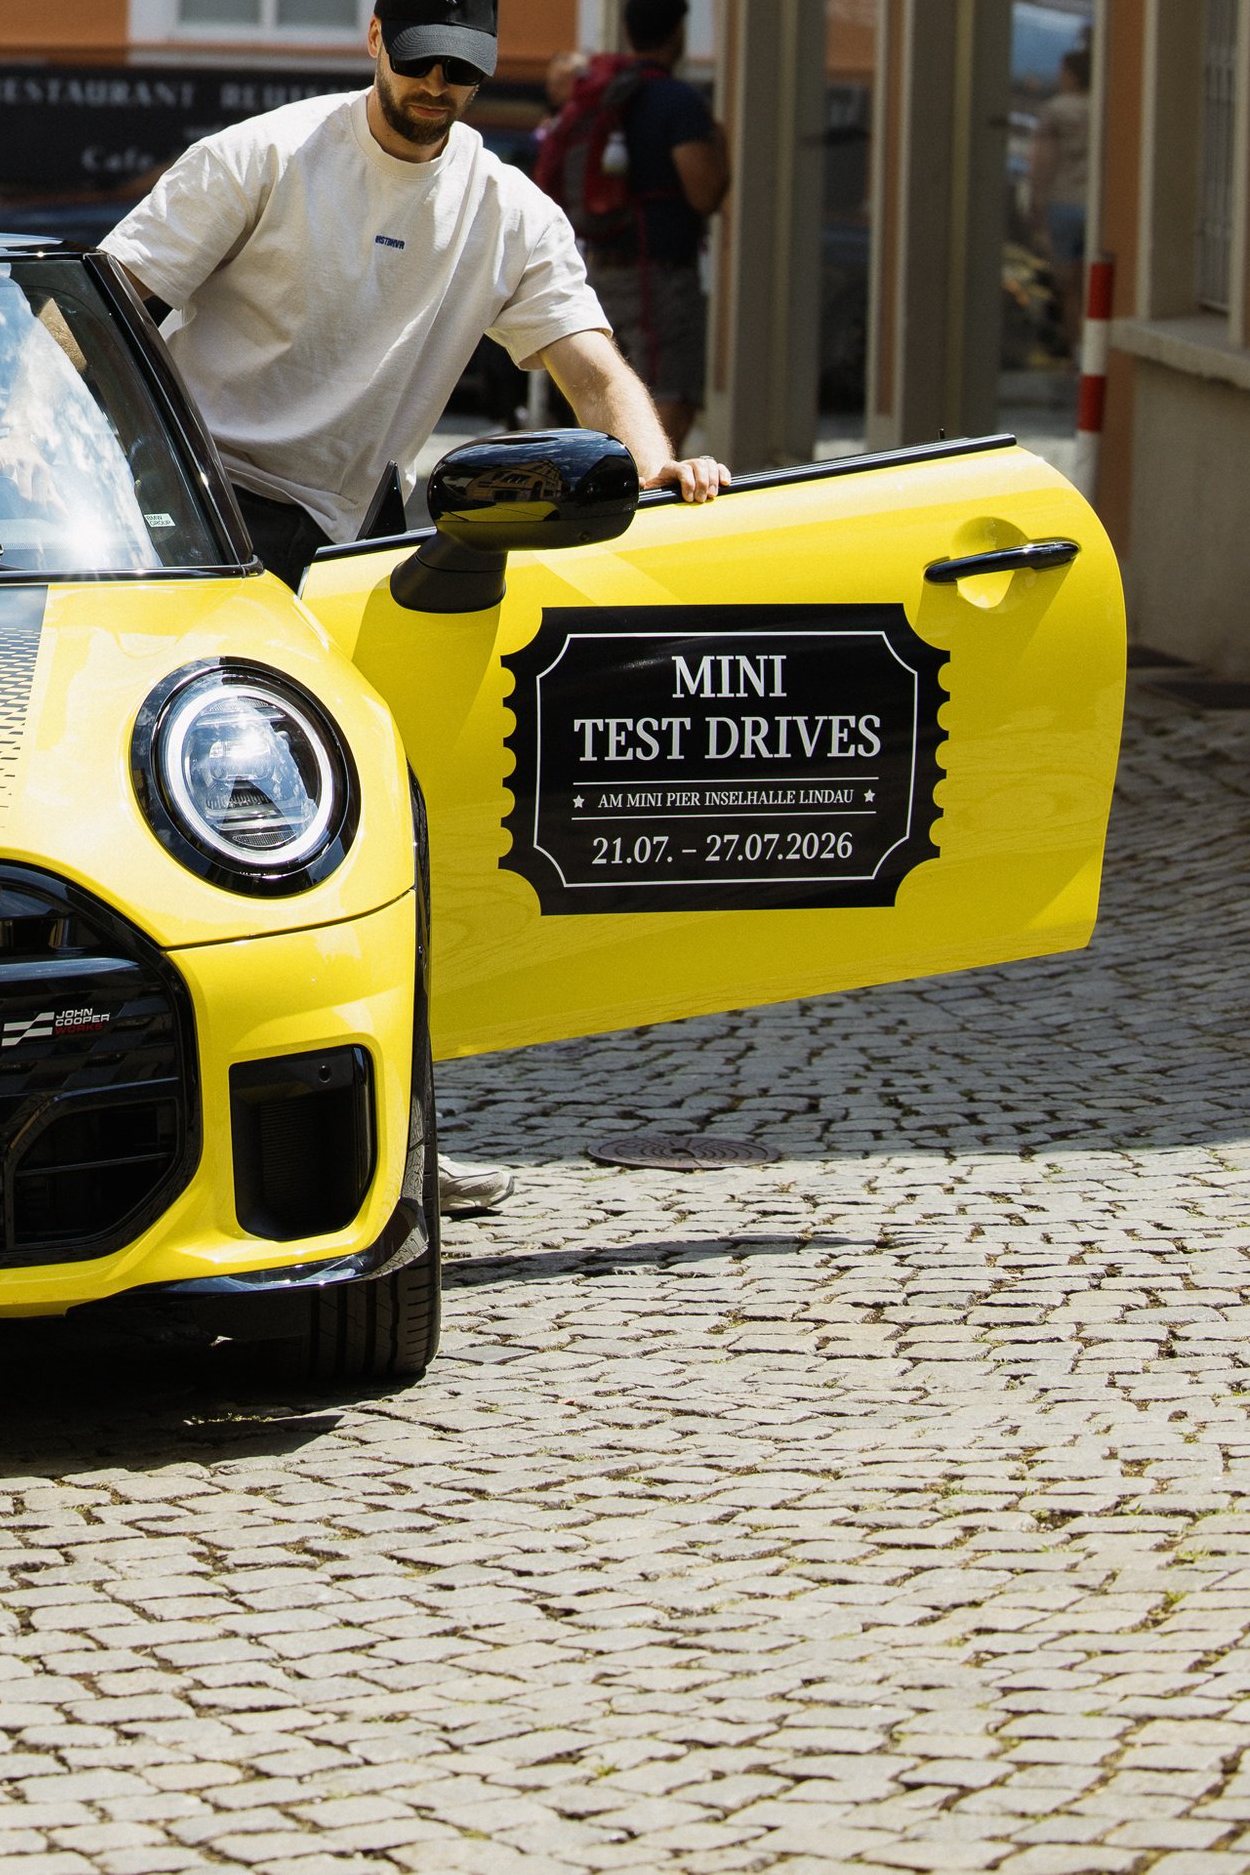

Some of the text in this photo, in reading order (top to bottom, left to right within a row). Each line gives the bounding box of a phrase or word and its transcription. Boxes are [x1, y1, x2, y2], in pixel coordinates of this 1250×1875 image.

[671, 655, 787, 699] MINI
[574, 714, 881, 762] TEST DRIVES
[598, 789, 855, 808] AM MINI PIER INSELHALLE LINDAU
[592, 836, 673, 865] 21.07.
[705, 832, 853, 862] 27.07.2026
[55, 1008, 93, 1019] JOHN
[55, 1013, 110, 1027] COOPER
[55, 1023, 103, 1034] WORKS
